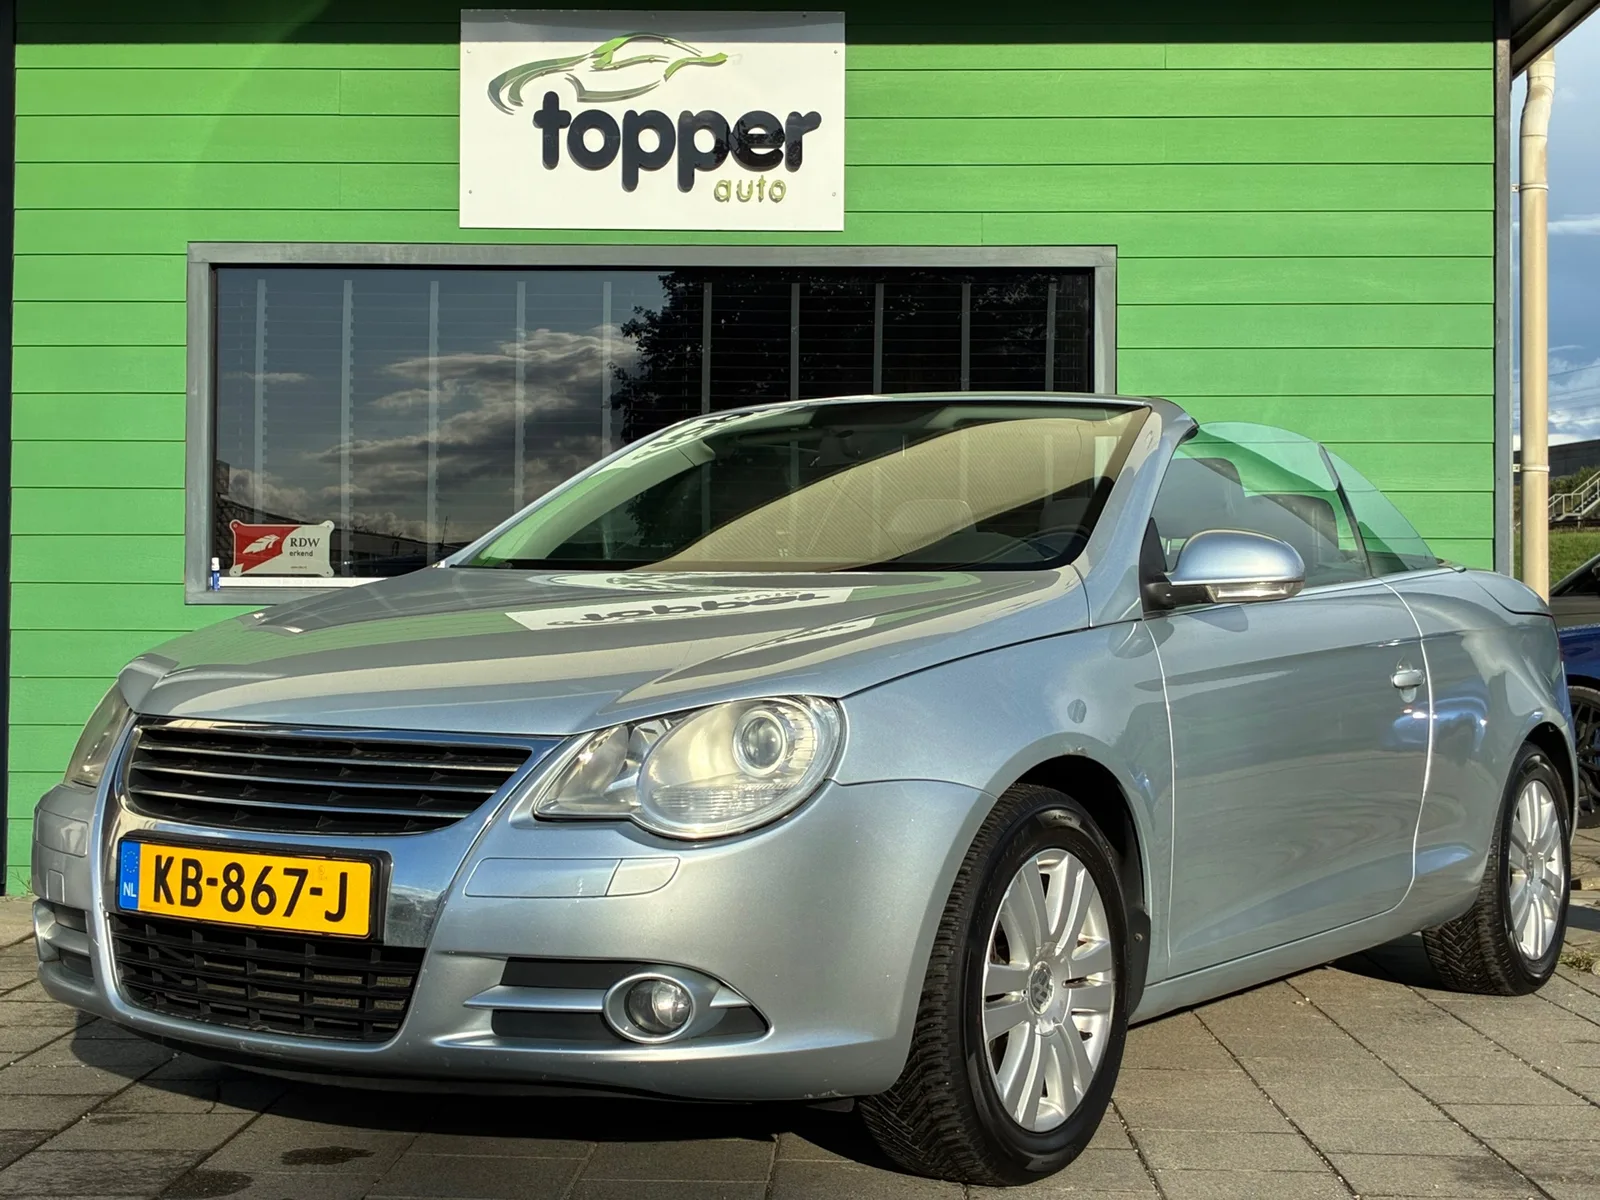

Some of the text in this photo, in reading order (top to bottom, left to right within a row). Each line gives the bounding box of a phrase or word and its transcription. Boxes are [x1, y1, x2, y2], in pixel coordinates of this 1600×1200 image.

[533, 91, 821, 193] topper
[714, 175, 786, 202] auto
[289, 549, 313, 557] erkend
[290, 537, 320, 548] RDW
[123, 882, 137, 898] NL
[153, 854, 348, 922] KB-867-J
